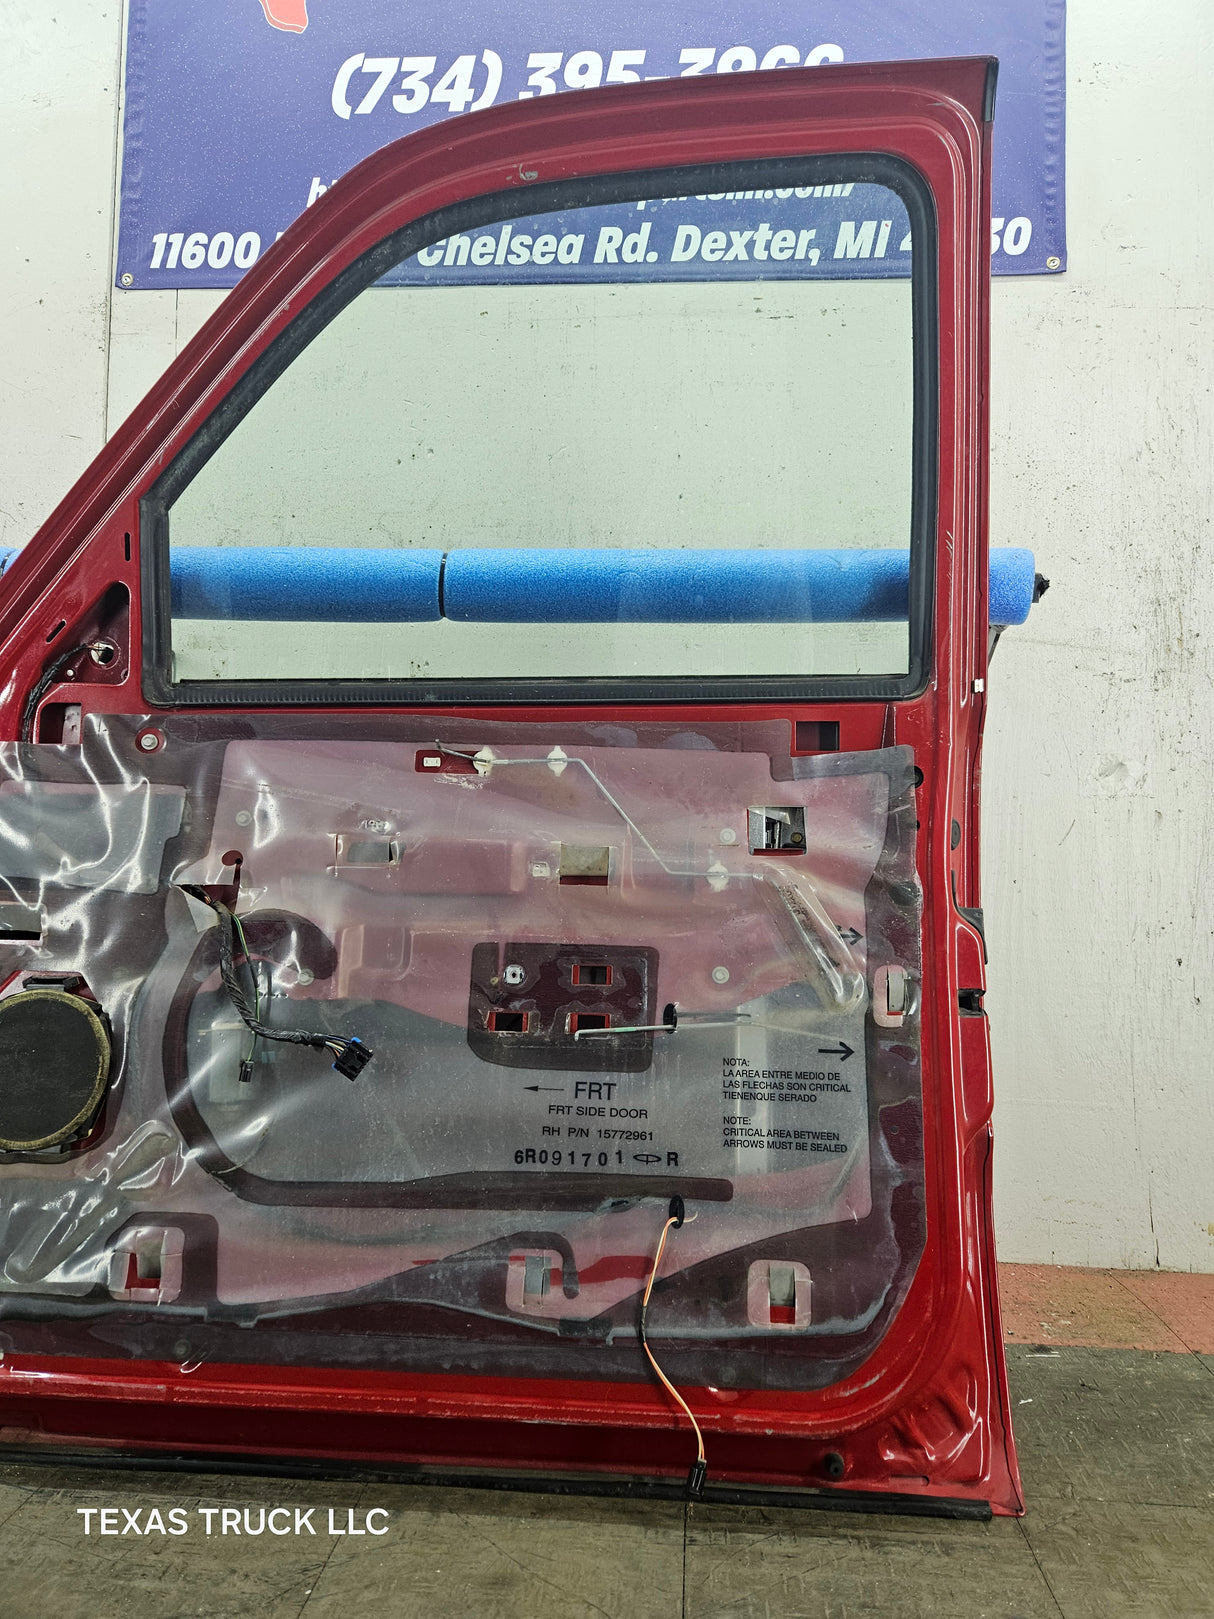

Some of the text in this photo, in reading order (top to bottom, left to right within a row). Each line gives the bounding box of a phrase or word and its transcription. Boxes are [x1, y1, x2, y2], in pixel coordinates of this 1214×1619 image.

[332, 49, 503, 120] (734)
[150, 232, 261, 269] 11600
[417, 224, 583, 267] Chelsea
[593, 222, 659, 264] Rd.
[670, 223, 820, 266] Dexter,
[833, 220, 893, 259] MI
[722, 1058, 750, 1067] NOTA:
[722, 1069, 841, 1081] LA AREA ENTRE MEDIO DE
[574, 1081, 617, 1100] FRT
[722, 1080, 852, 1093] LAS FLECHAS SON CRITICAL
[722, 1091, 818, 1103] TIENENQUE SERADO
[548, 1105, 648, 1119] FRT SIDE DOOR
[722, 1116, 752, 1125] NOTE:
[542, 1126, 654, 1141] RH P/N 15772961
[722, 1127, 840, 1141] CRITICAL AREA BETWEEN
[722, 1139, 848, 1154] ARROWS MUST BE SEALED
[666, 1151, 679, 1167] R
